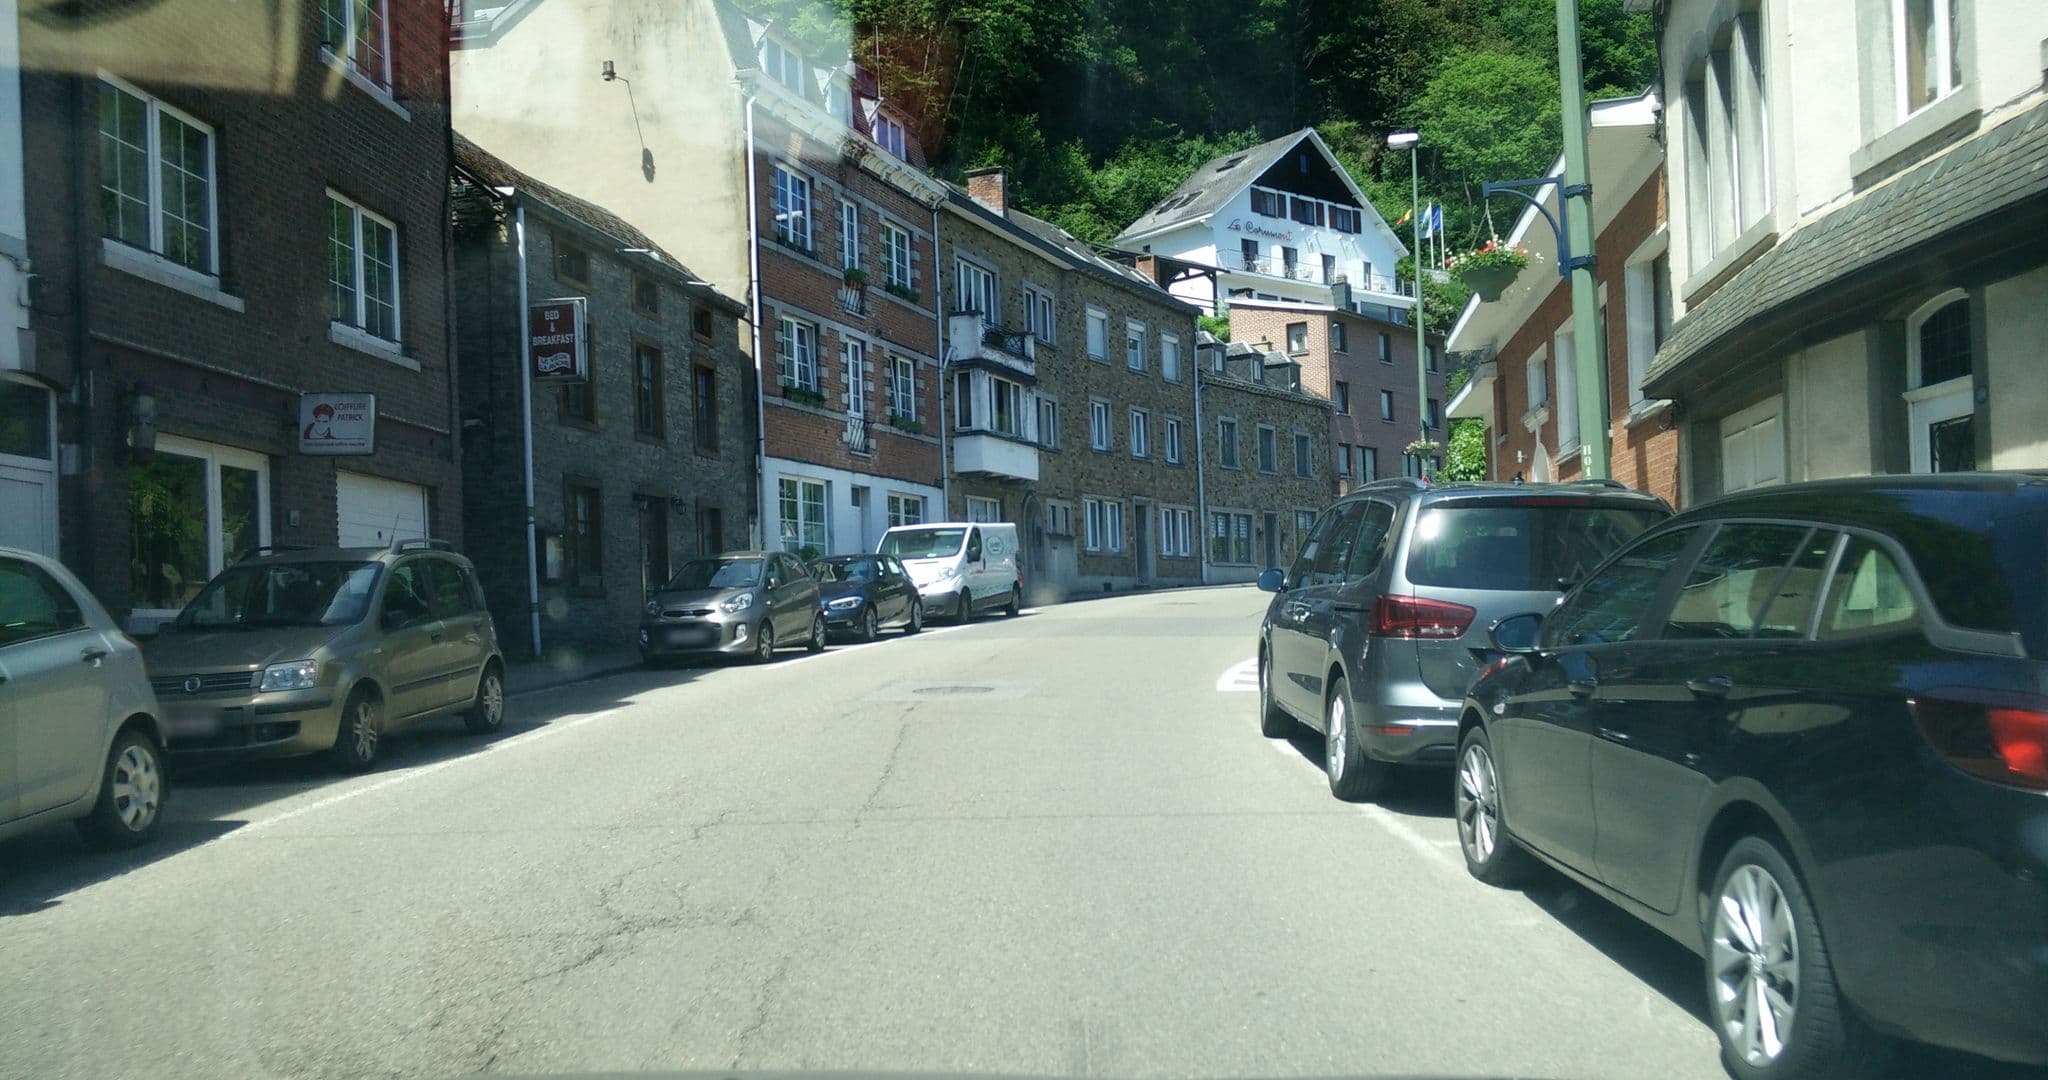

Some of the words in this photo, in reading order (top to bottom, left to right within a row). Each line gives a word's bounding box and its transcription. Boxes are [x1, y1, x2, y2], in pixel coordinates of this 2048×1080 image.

[544, 310, 559, 320] BED
[550, 322, 556, 332] &
[533, 333, 573, 346] BREAKFAST
[334, 402, 367, 410] COIFFURE
[337, 413, 363, 422] PATRICK
